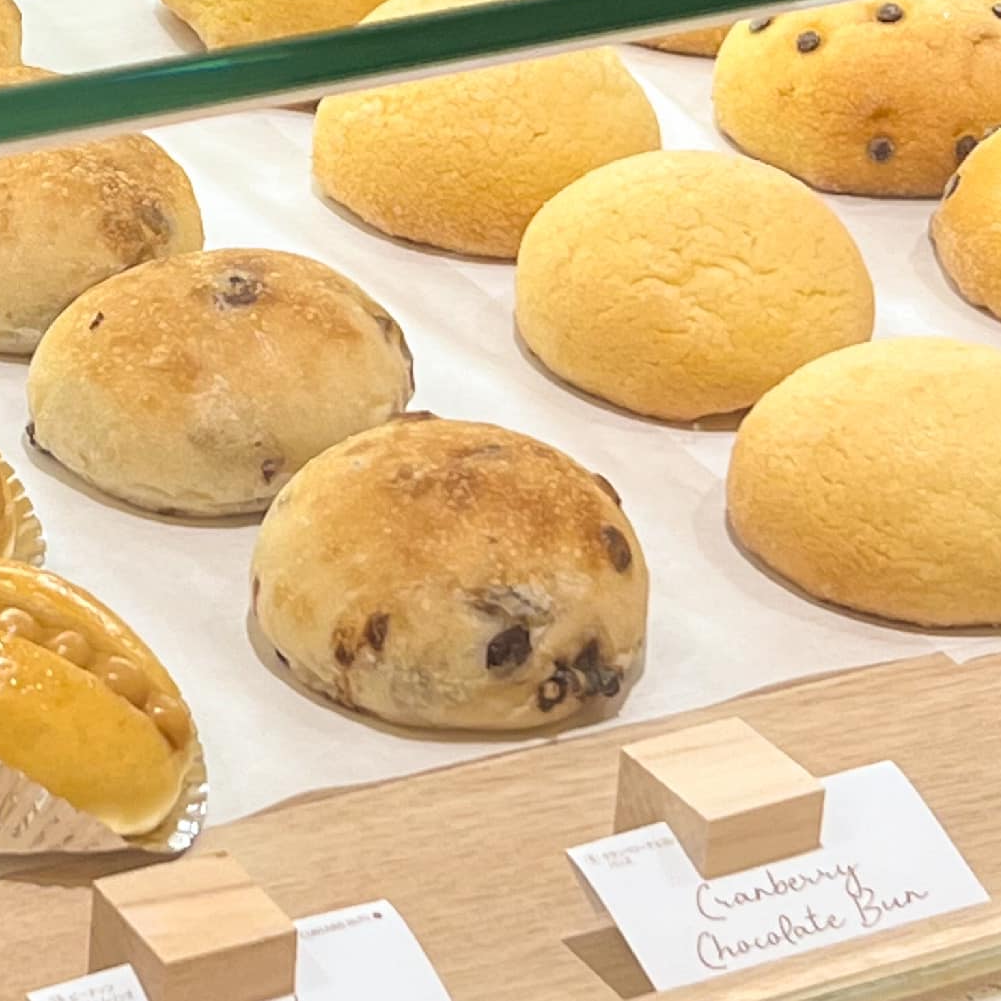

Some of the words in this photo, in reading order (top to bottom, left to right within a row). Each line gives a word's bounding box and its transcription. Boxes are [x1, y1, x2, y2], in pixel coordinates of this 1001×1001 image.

[697, 863, 861, 921] Cranberry
[697, 905, 846, 969] Chocolate
[859, 887, 929, 928] Bun
